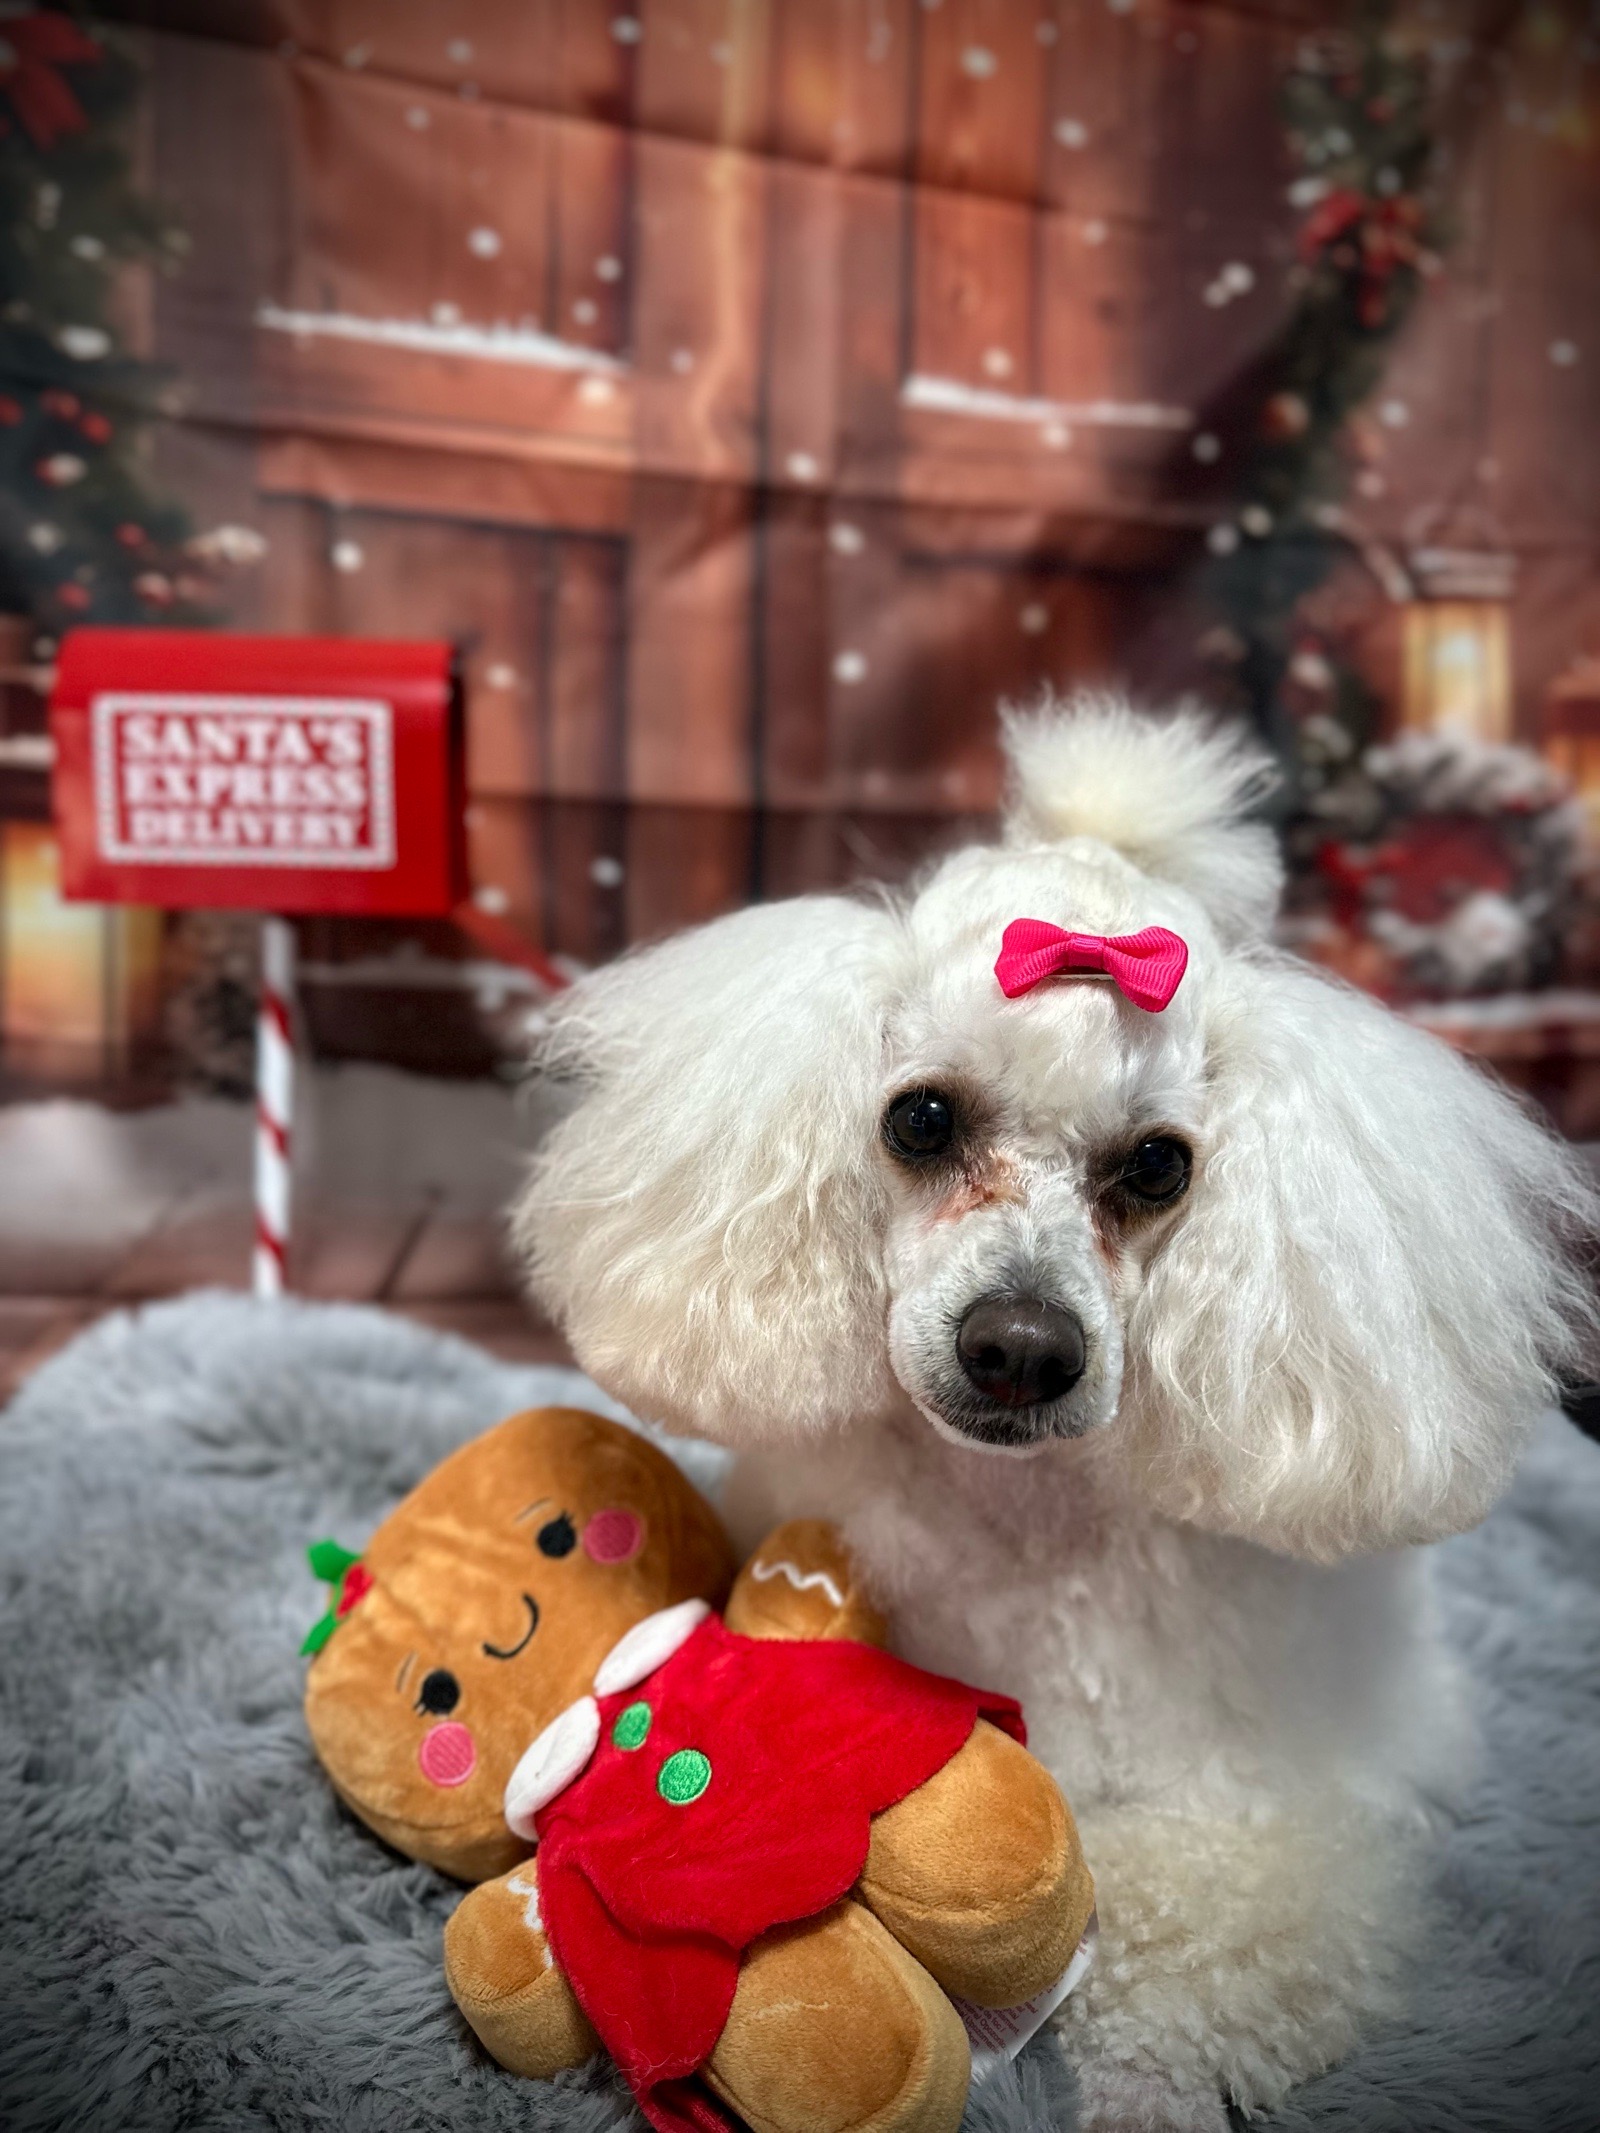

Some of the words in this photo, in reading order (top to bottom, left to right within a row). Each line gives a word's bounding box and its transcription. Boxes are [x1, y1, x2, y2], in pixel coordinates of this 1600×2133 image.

[122, 714, 363, 763] SANTA'S
[124, 765, 366, 807] EXPRESS
[130, 808, 363, 846] DELIVERY
